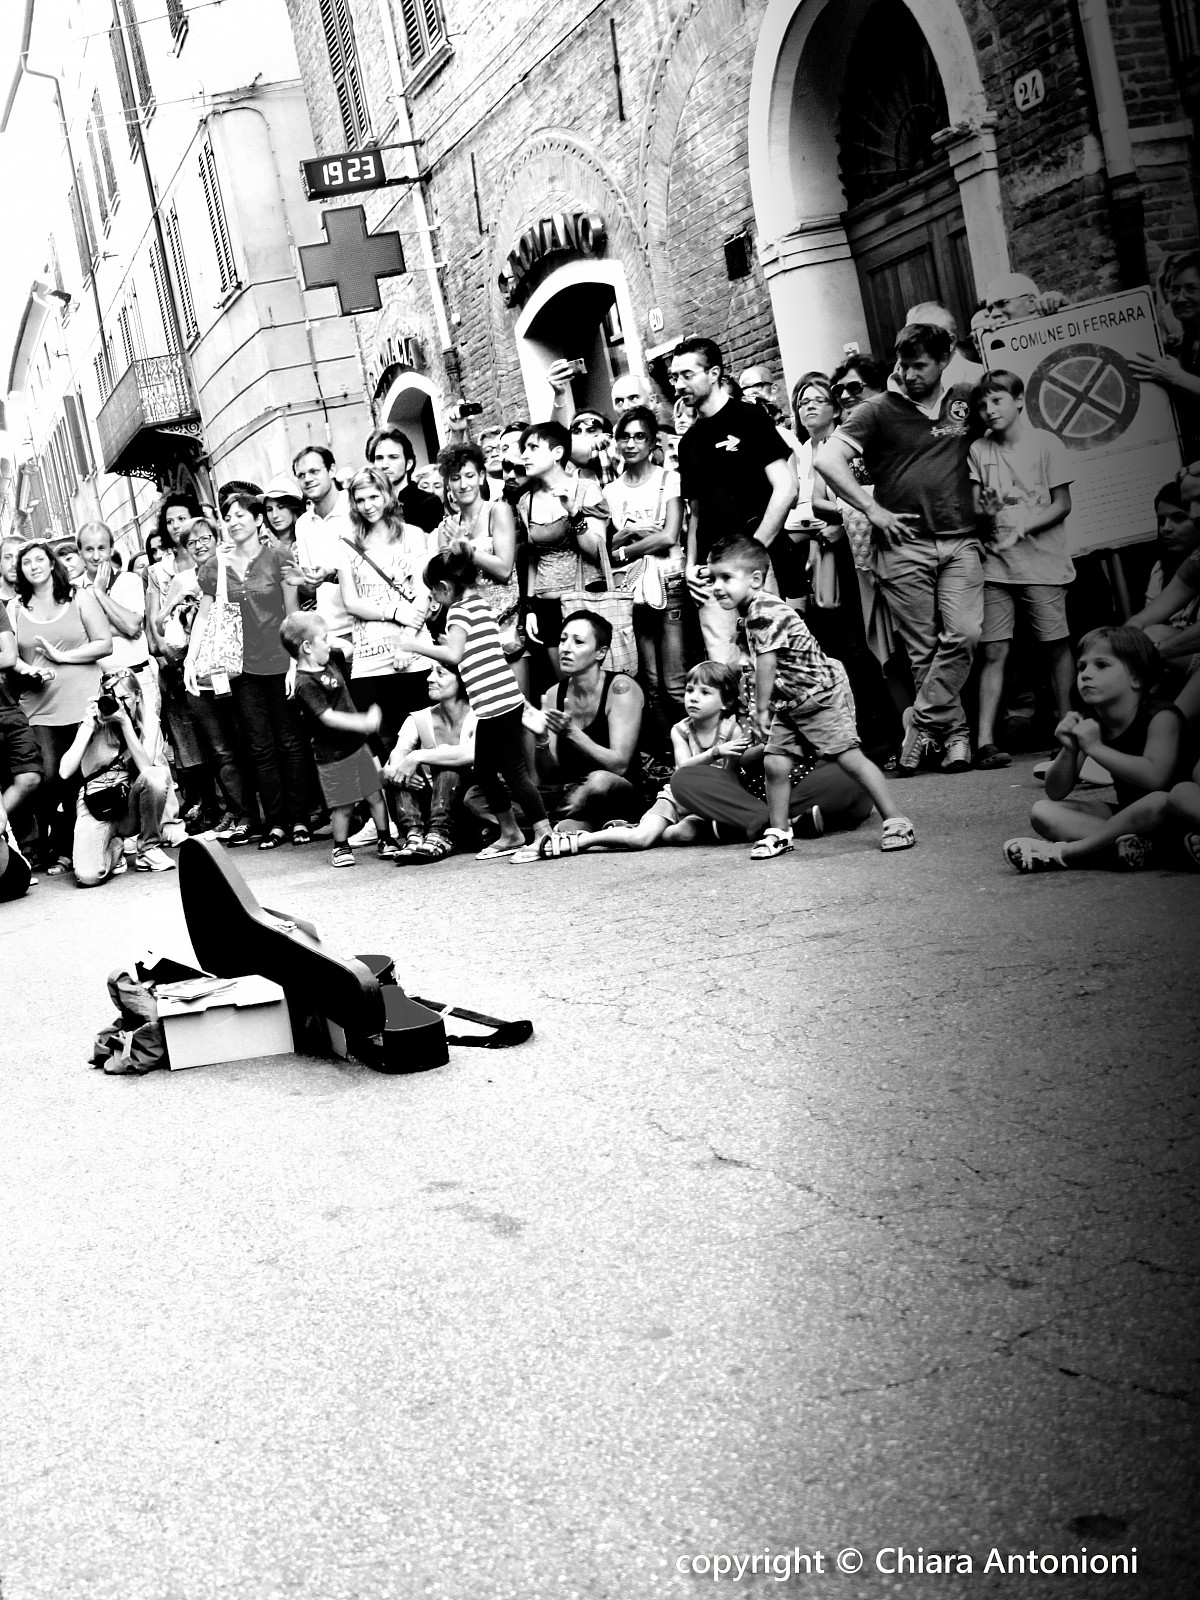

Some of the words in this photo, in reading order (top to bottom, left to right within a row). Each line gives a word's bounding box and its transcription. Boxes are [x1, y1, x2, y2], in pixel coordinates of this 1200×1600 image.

[1018, 76, 1041, 107] 24
[1010, 325, 1065, 351] COMUNE
[1067, 321, 1081, 338] DI
[1083, 305, 1146, 333] FERRARA
